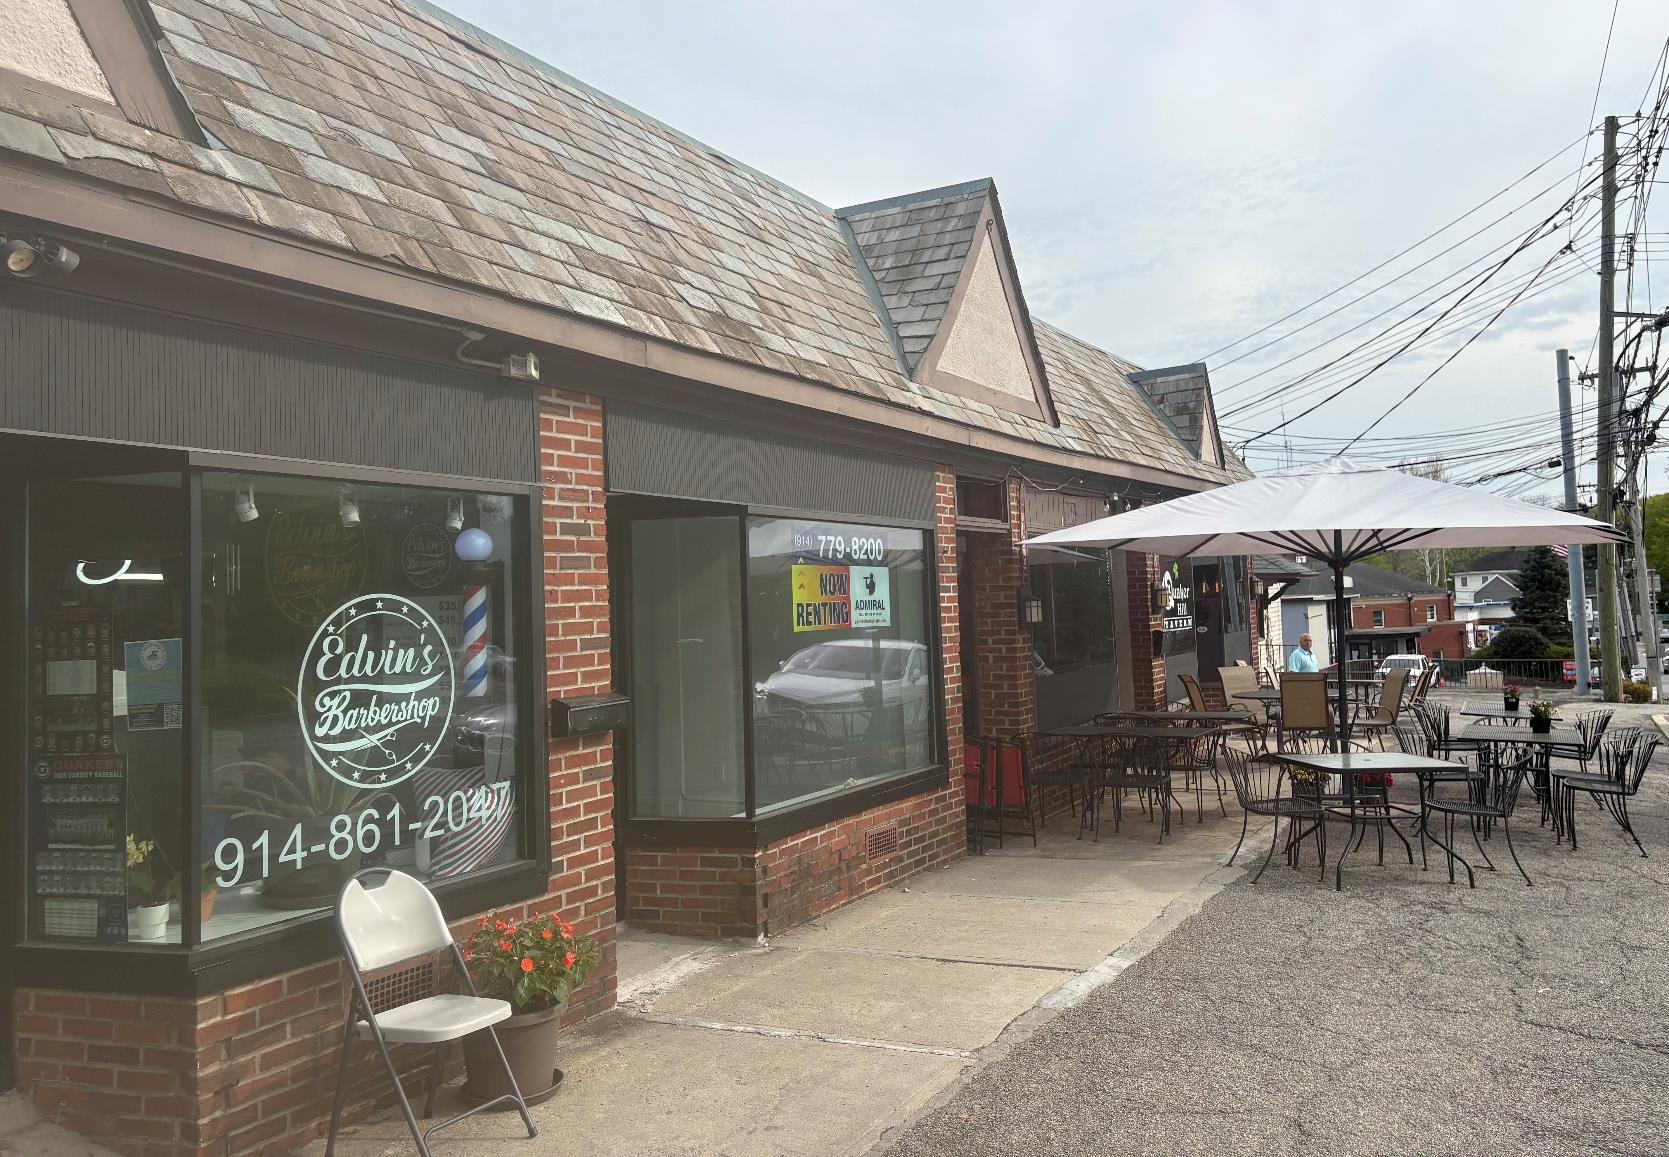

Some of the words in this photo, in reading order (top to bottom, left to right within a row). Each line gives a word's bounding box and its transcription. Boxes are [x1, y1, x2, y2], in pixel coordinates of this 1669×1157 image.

[794, 534, 813, 548] (914)
[817, 535, 884, 561] 779-8200
[819, 572, 849, 597] NOW
[796, 601, 849, 627] RENTING
[855, 599, 886, 611] ADMIRAL
[1164, 618, 1192, 629] TAVERN
[316, 633, 440, 681] Edvin's
[314, 691, 440, 739] Barbershop
[54, 760, 124, 770] QUAKERS
[213, 780, 511, 888] 914-861-2047
